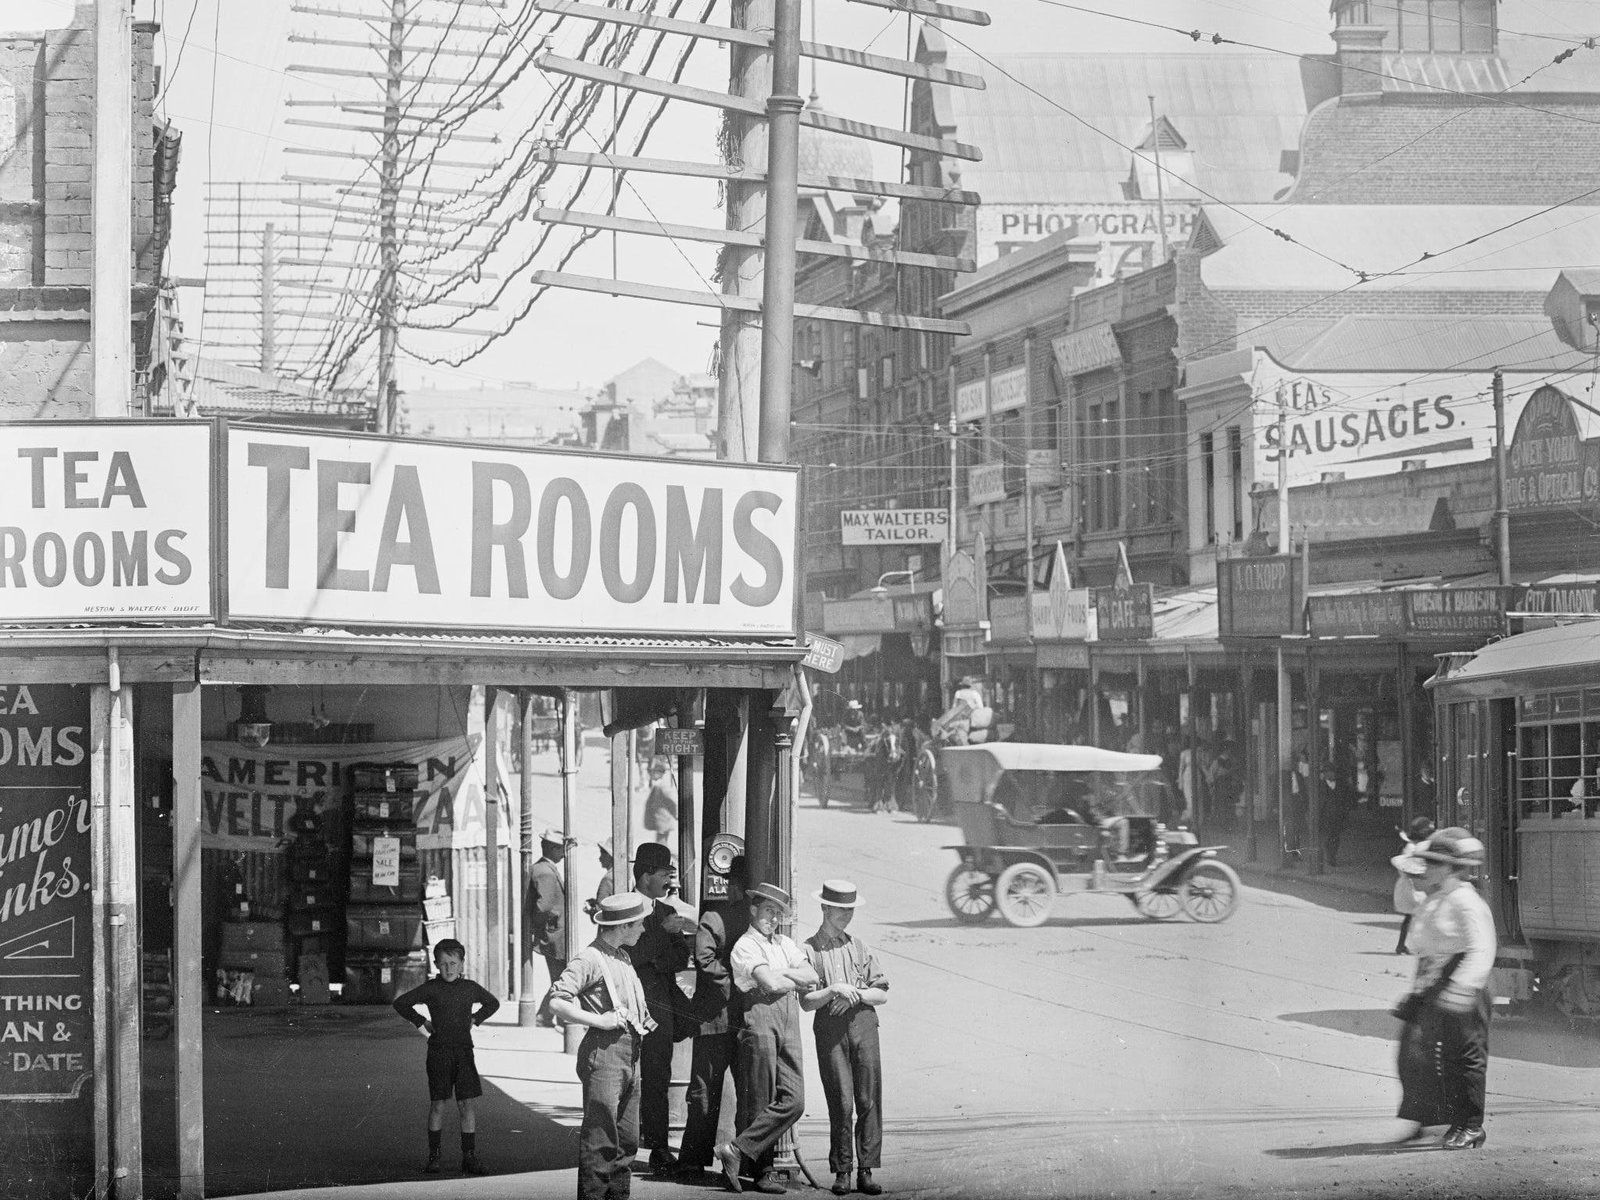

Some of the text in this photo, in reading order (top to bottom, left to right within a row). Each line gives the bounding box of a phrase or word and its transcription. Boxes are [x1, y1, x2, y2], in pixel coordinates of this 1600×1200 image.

[1265, 394, 1466, 462] SAUSAGES.
[17, 447, 147, 509] TEA
[1504, 477, 1527, 504] RUG
[247, 442, 784, 608] TEA ROOMS
[843, 510, 948, 527] MAX WALTERS
[867, 526, 935, 541] TAILOR.
[0, 526, 192, 588] ROOMS
[813, 640, 838, 658] MUST
[804, 653, 834, 670] HERE
[664, 730, 696, 740] KEEP
[662, 744, 698, 753] RIGHT
[200, 755, 456, 787] AMERIN
[52, 1021, 72, 1042] &
